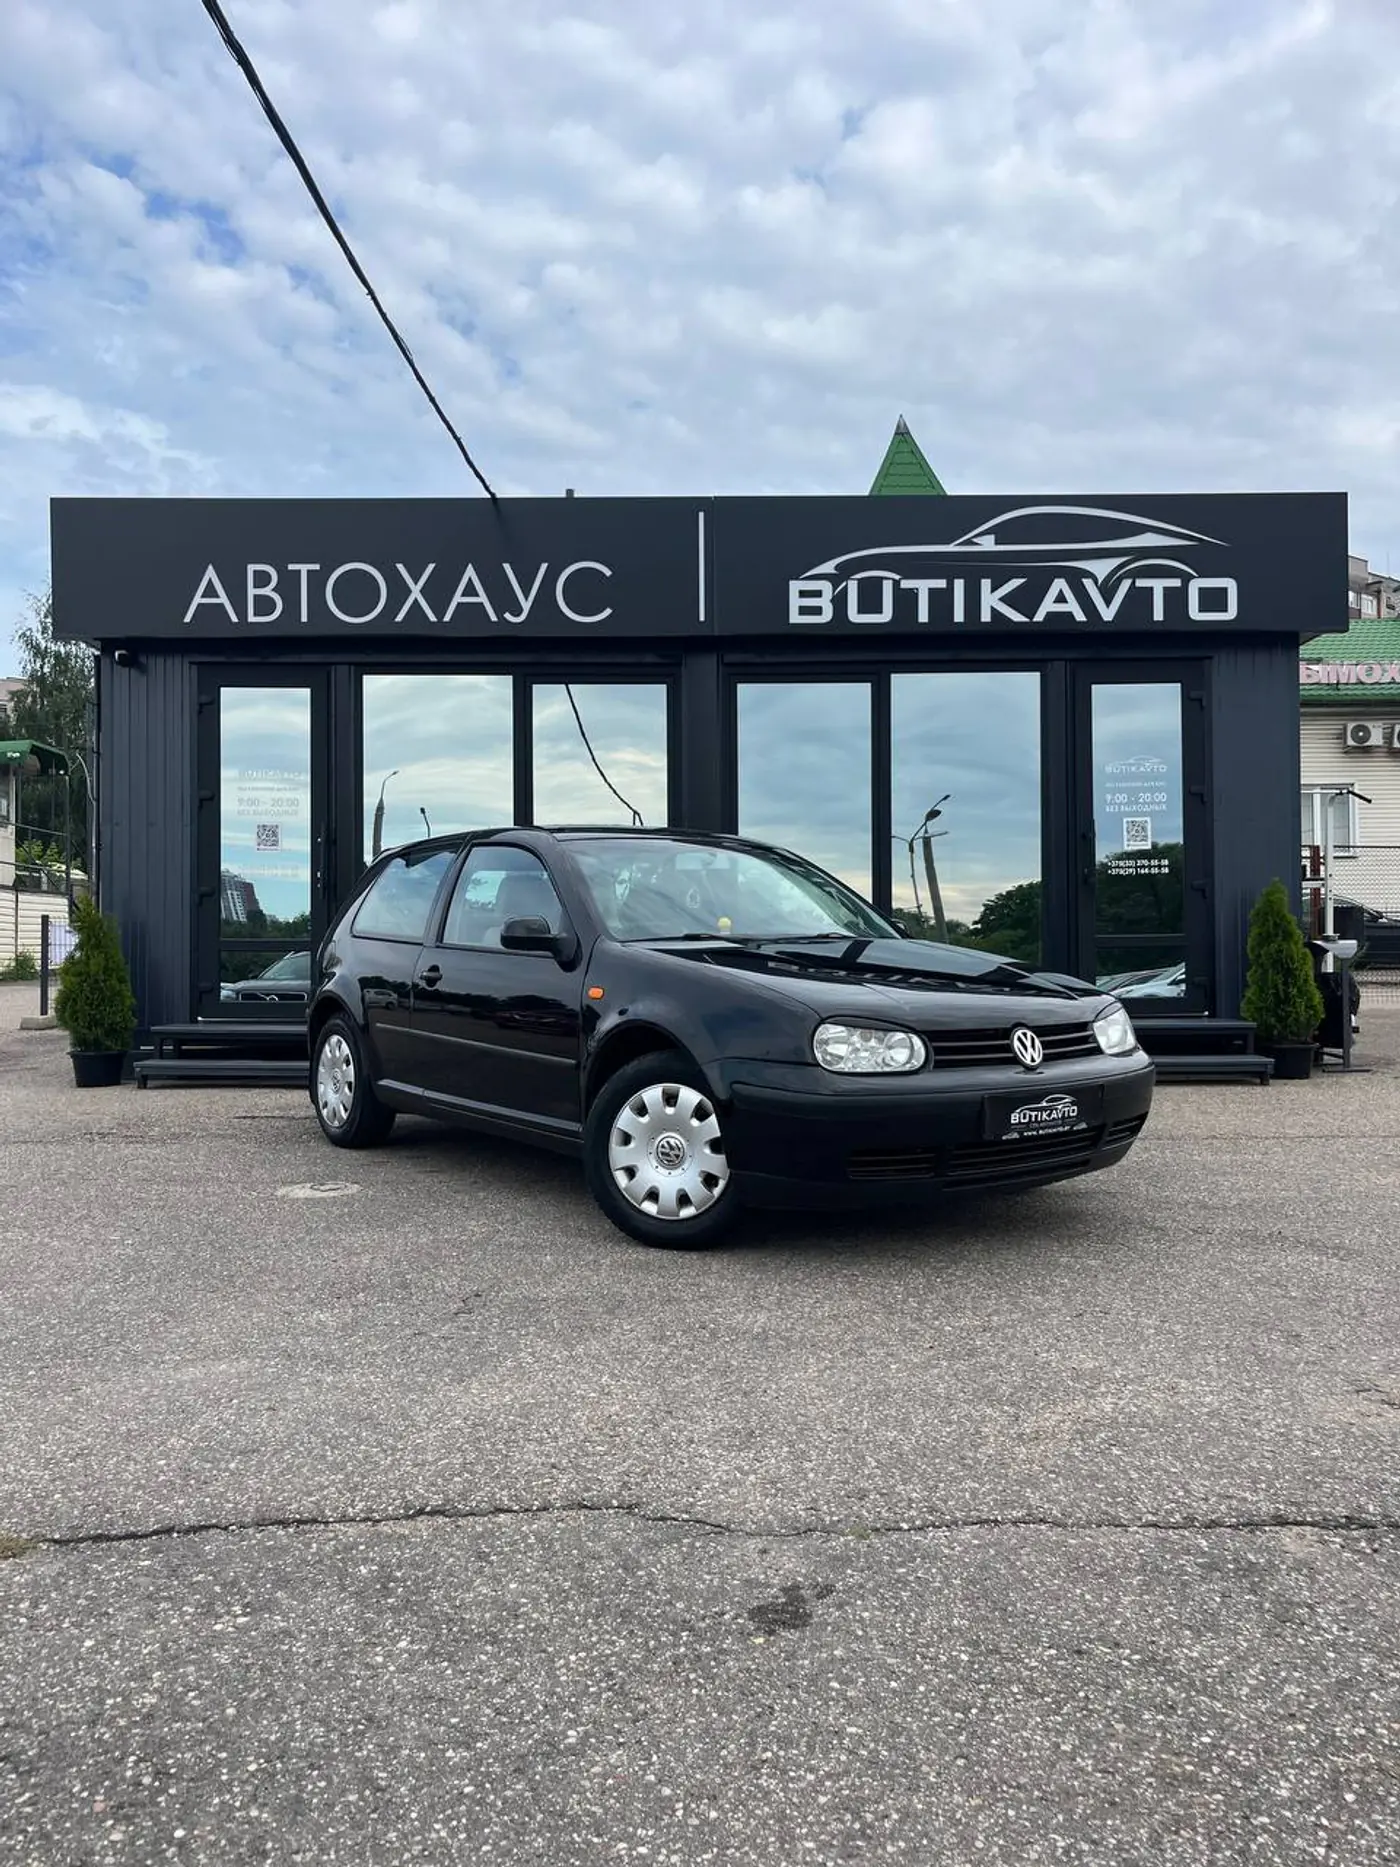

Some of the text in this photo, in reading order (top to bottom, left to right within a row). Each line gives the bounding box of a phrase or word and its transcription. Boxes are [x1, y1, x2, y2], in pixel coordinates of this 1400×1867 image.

[183, 560, 614, 624] АВТОХАУС
[788, 577, 1239, 624] BUTIKAVTO
[1138, 792, 1168, 803] 20:00
[1010, 1105, 1078, 1124] BUTIKAVTO
